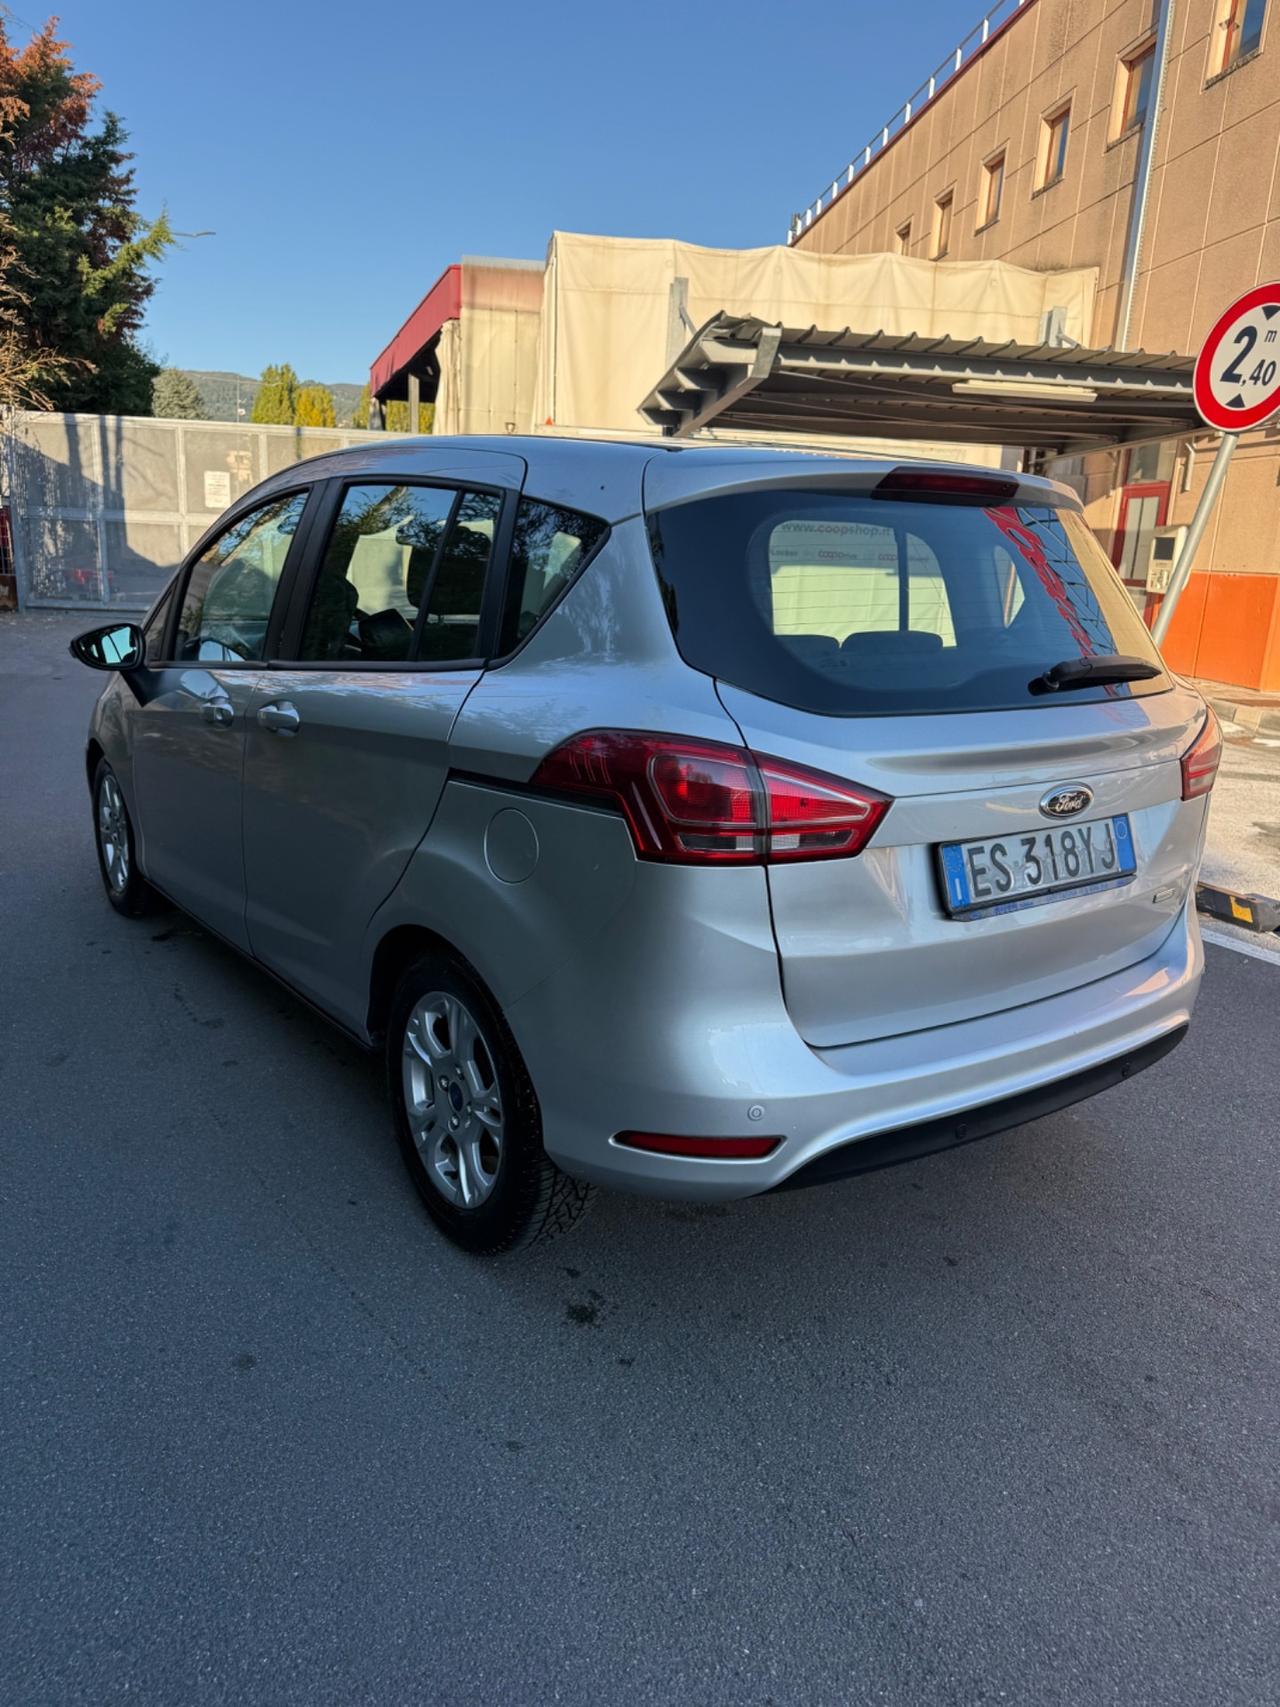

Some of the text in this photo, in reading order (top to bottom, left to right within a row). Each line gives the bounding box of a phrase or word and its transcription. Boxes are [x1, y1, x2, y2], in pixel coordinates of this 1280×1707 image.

[1264, 330, 1277, 343] m
[782, 523, 891, 538] www.coopshop.it
[1055, 793, 1084, 812] Ford
